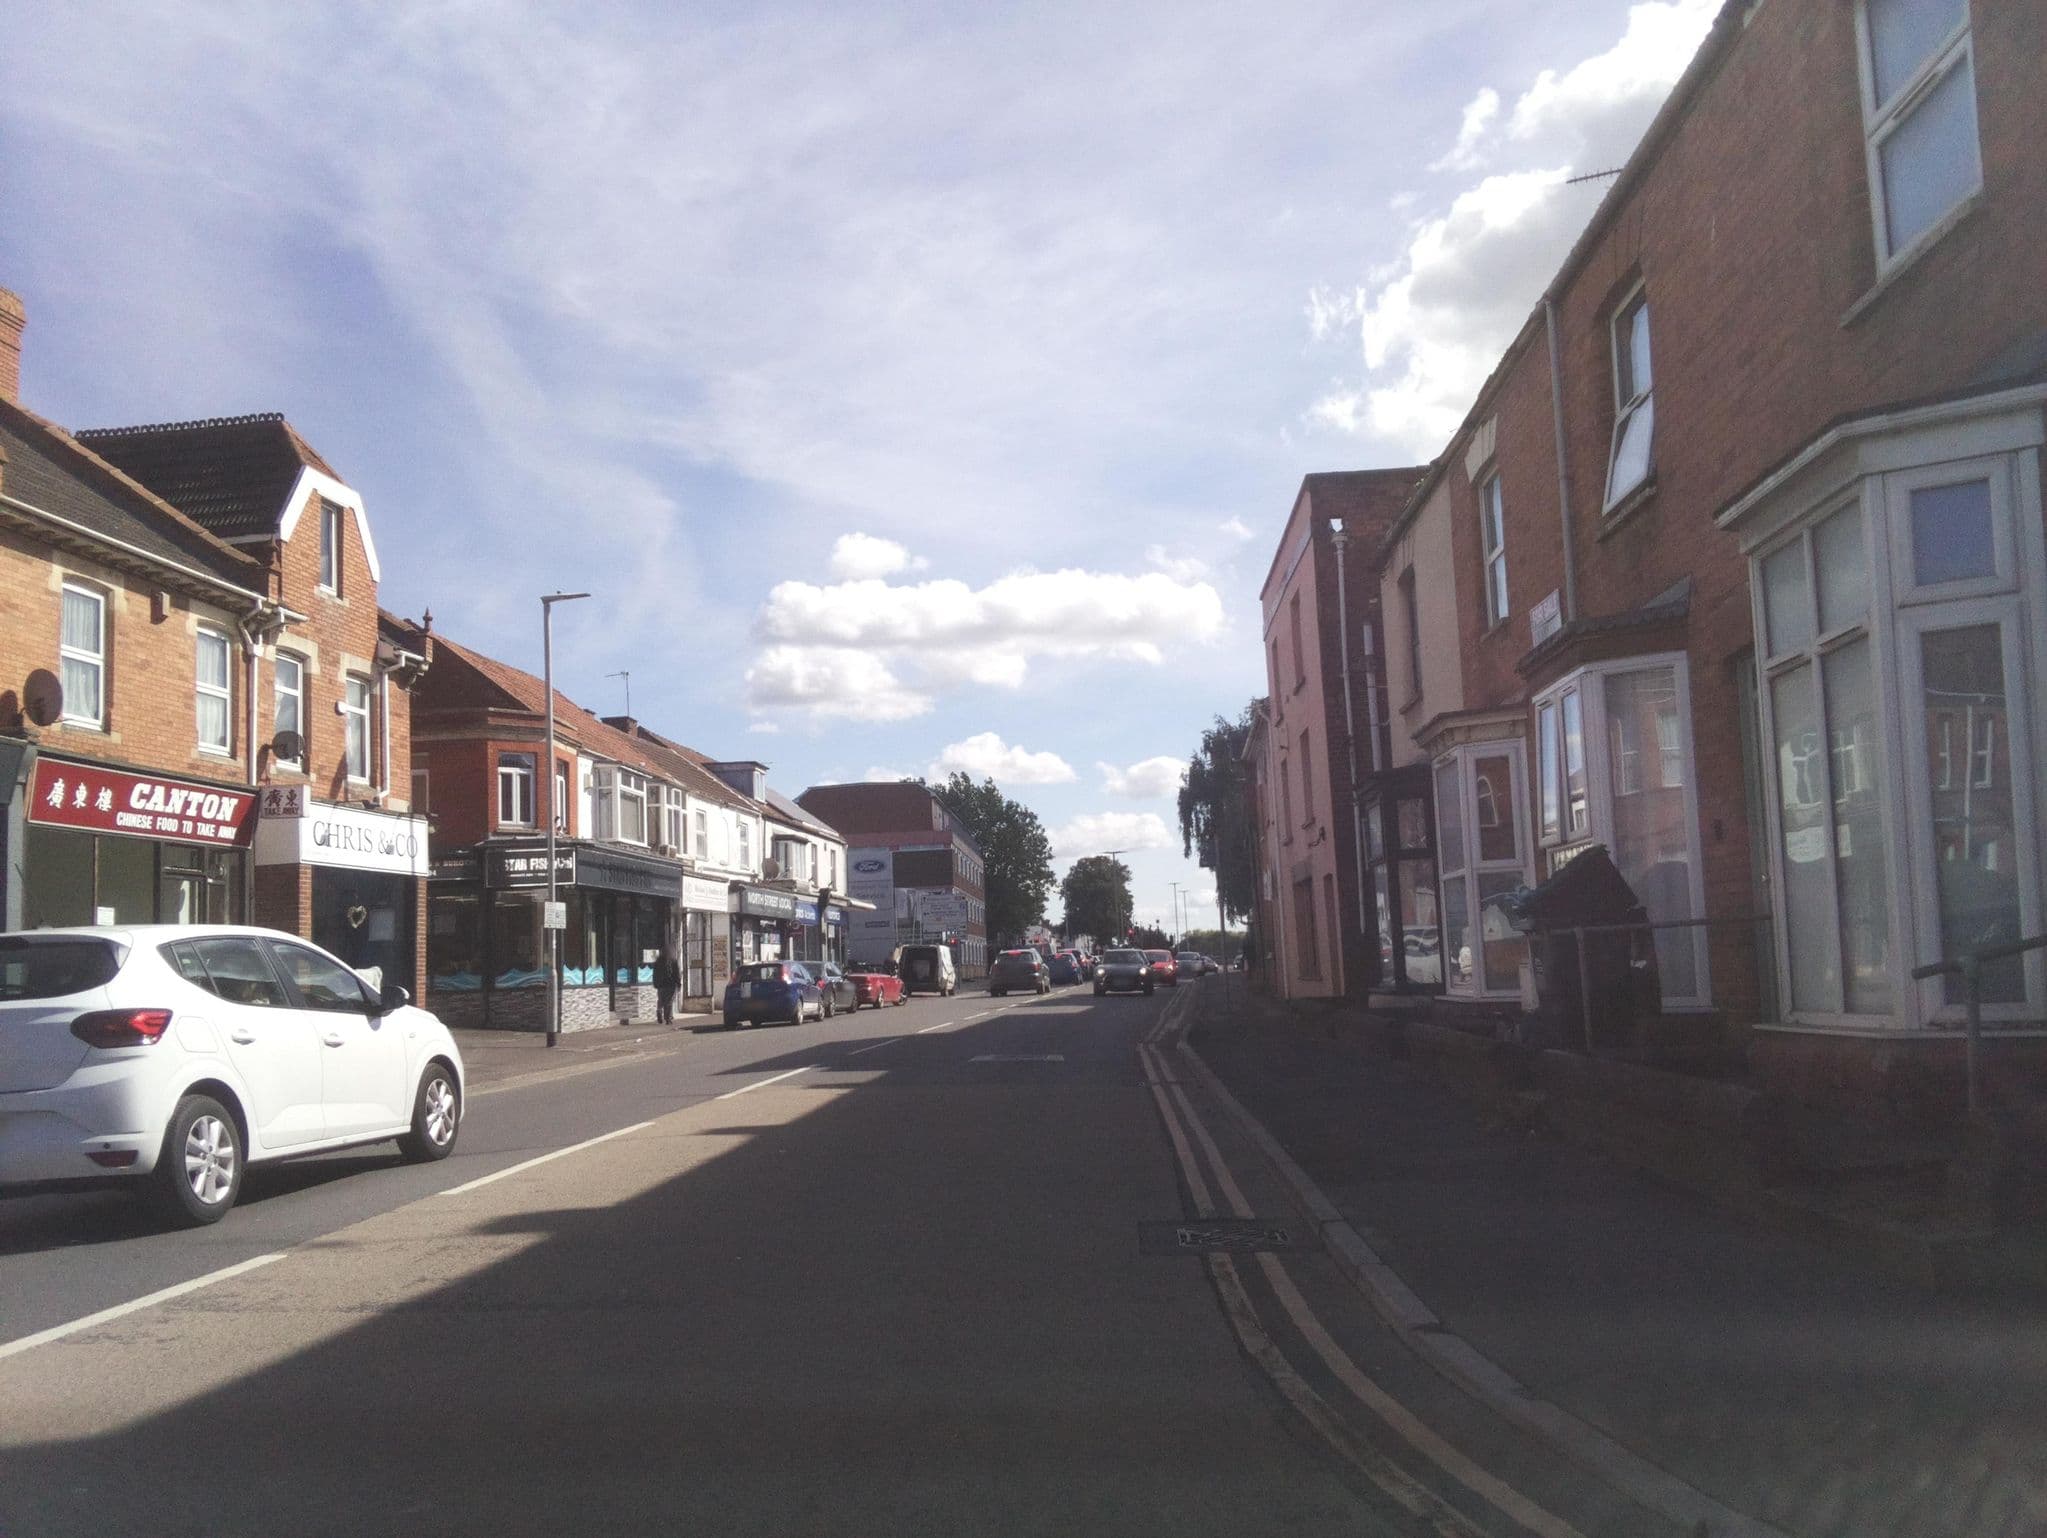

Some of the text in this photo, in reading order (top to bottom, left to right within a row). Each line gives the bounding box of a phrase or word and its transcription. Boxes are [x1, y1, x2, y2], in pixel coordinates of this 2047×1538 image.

[130, 782, 239, 822] CANTON
[264, 807, 299, 816] TAKE AWAY
[116, 812, 238, 840] CHINESE FOOD TO TAKE AWAY
[313, 820, 373, 853] CHRIS
[396, 833, 418, 859] CO
[858, 860, 881, 872] Ford
[747, 891, 792, 910] NORTH STREET LOCAL
